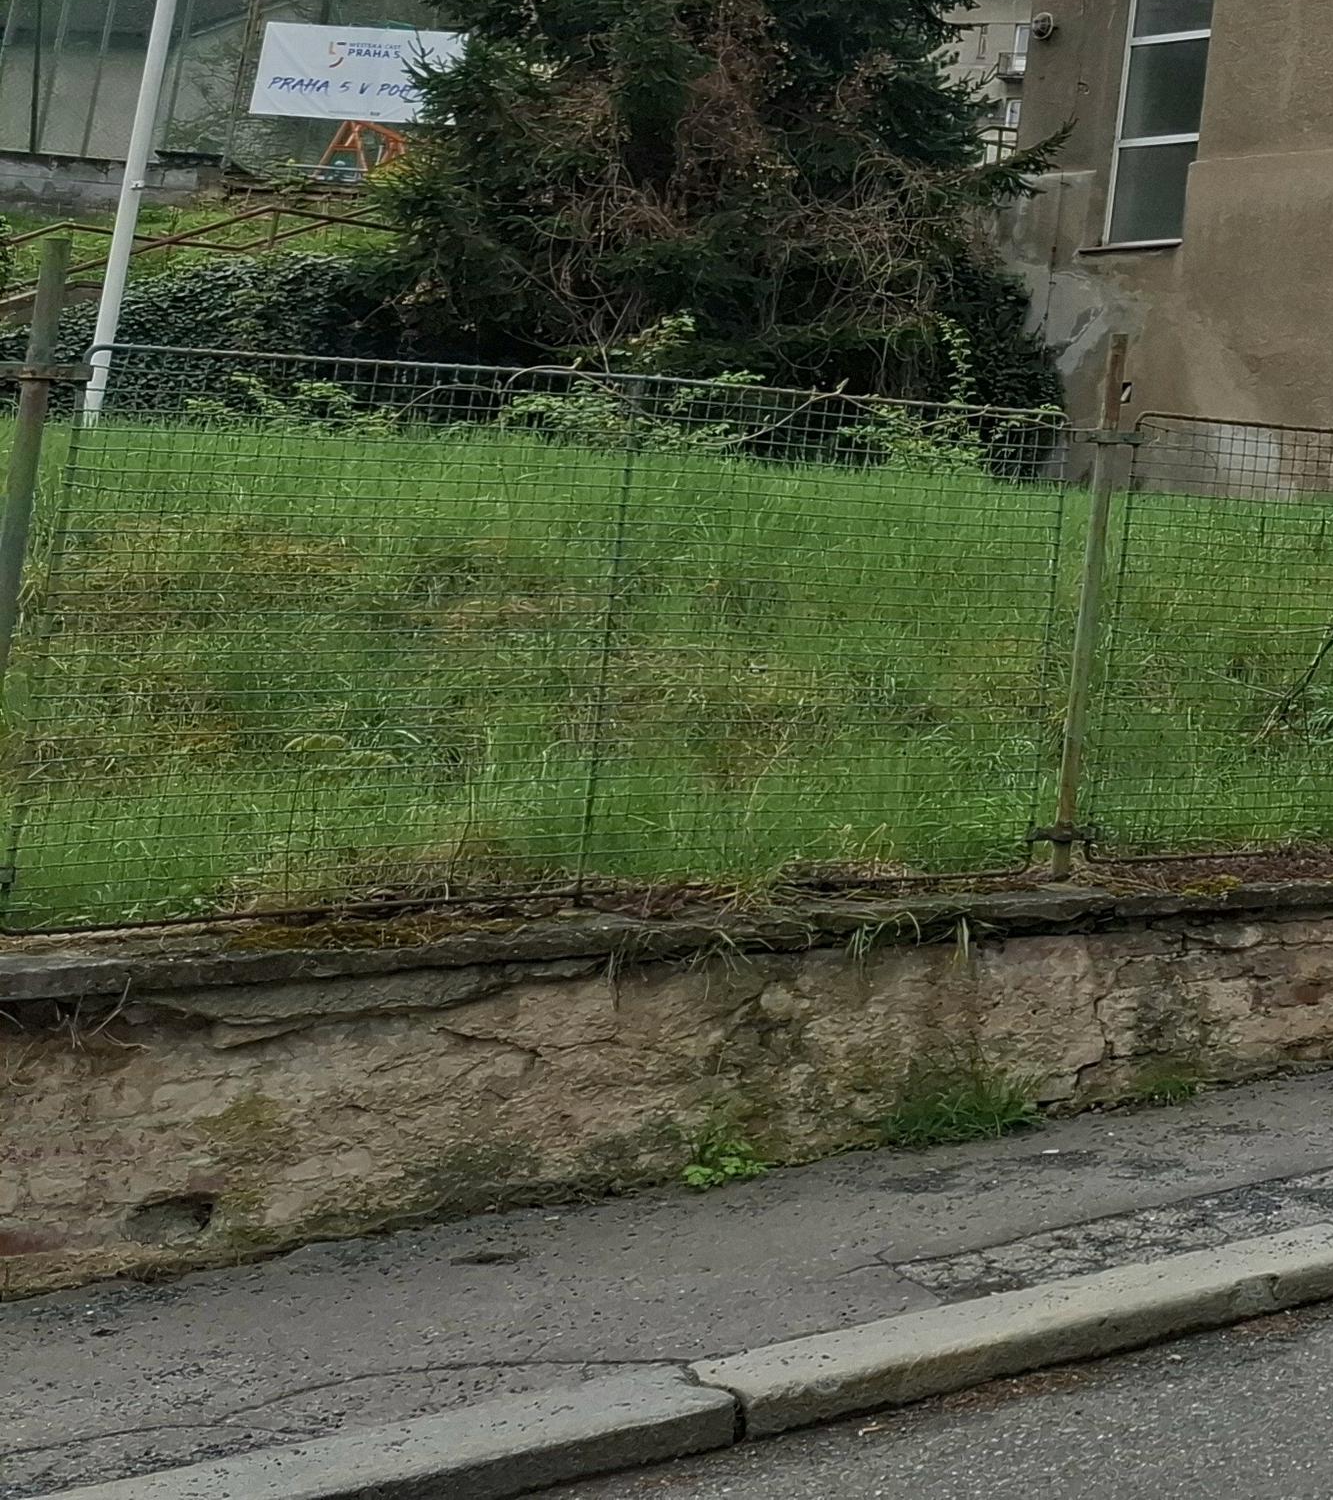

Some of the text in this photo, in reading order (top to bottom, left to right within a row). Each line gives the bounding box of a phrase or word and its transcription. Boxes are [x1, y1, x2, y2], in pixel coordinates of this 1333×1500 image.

[347, 48, 401, 59] PRAHA 5
[267, 76, 330, 94] PRAHA
[339, 81, 352, 92] 5
[359, 82, 370, 95] V
